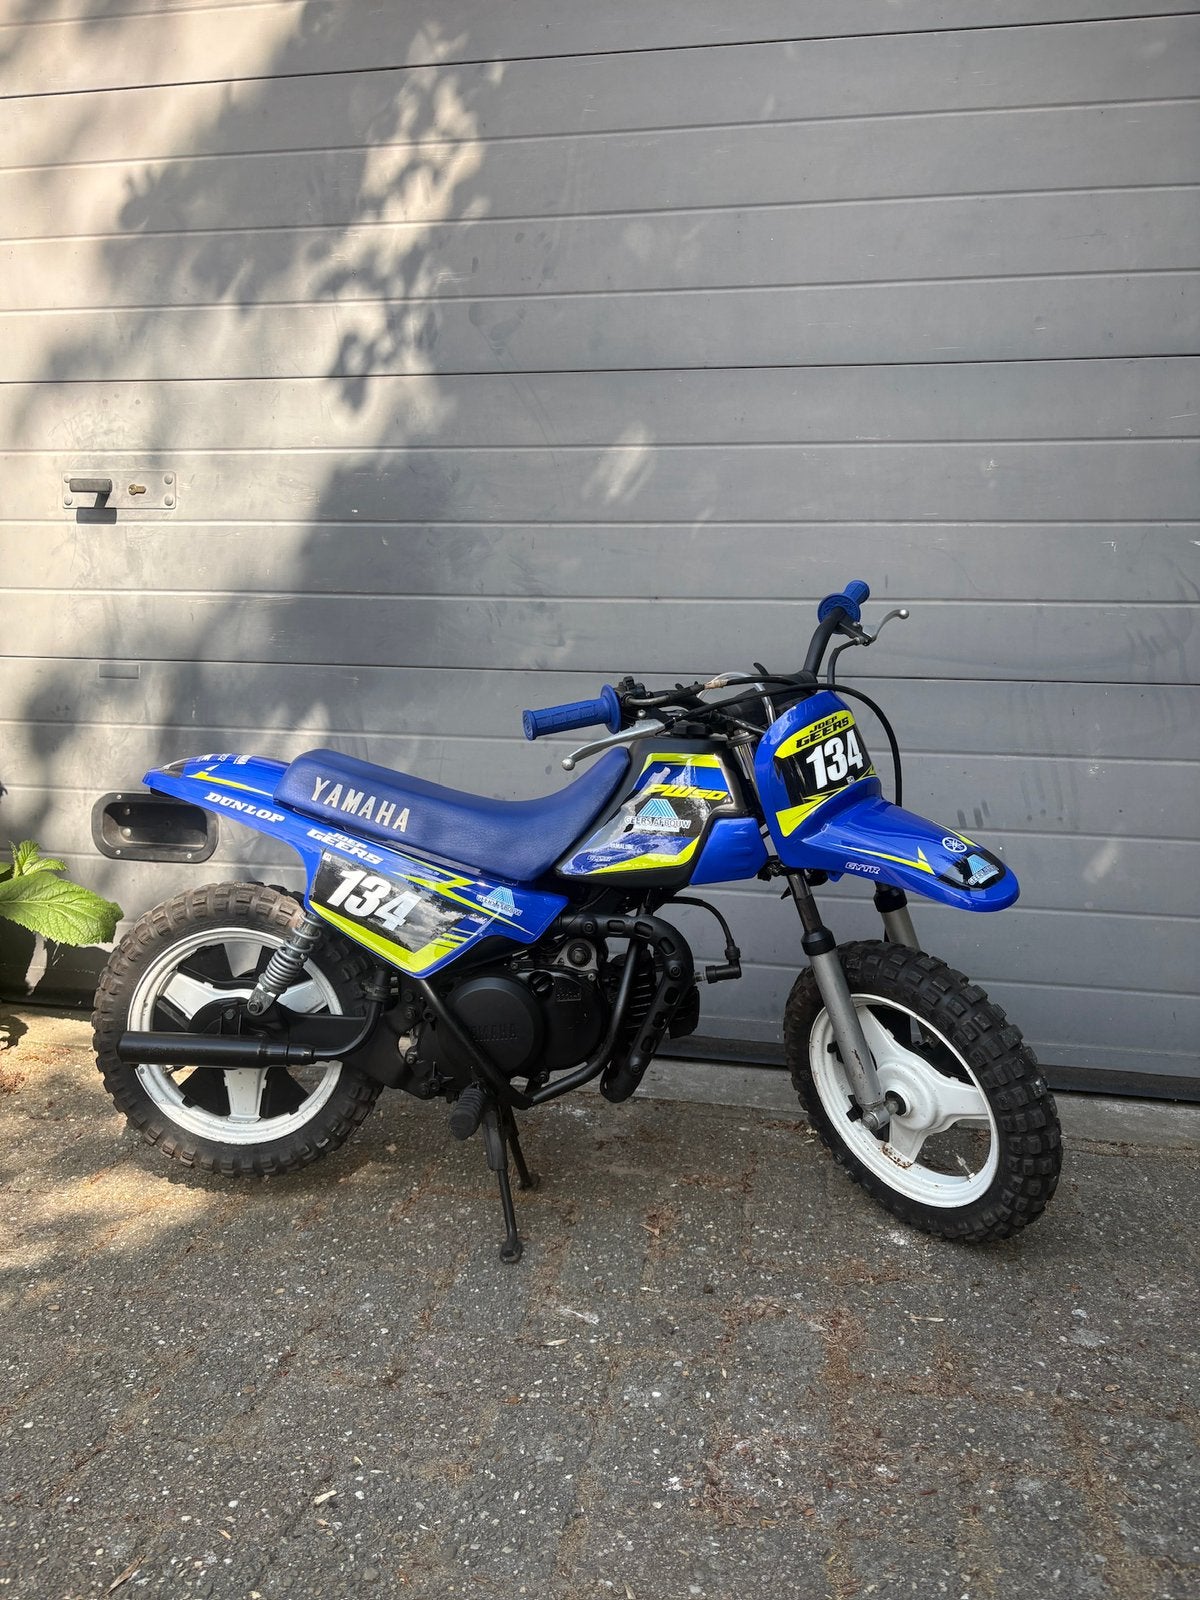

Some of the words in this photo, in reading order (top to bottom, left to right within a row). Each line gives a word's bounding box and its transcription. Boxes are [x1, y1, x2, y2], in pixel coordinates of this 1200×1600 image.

[795, 717, 850, 748] GEERS
[809, 716, 838, 733] JOEP
[805, 729, 864, 789] 134
[204, 791, 286, 823] DUNLOP
[310, 776, 411, 833] YAMAHA
[306, 828, 385, 865] GEERS
[326, 869, 422, 932] 134
[468, 1023, 519, 1042] AMAHA
